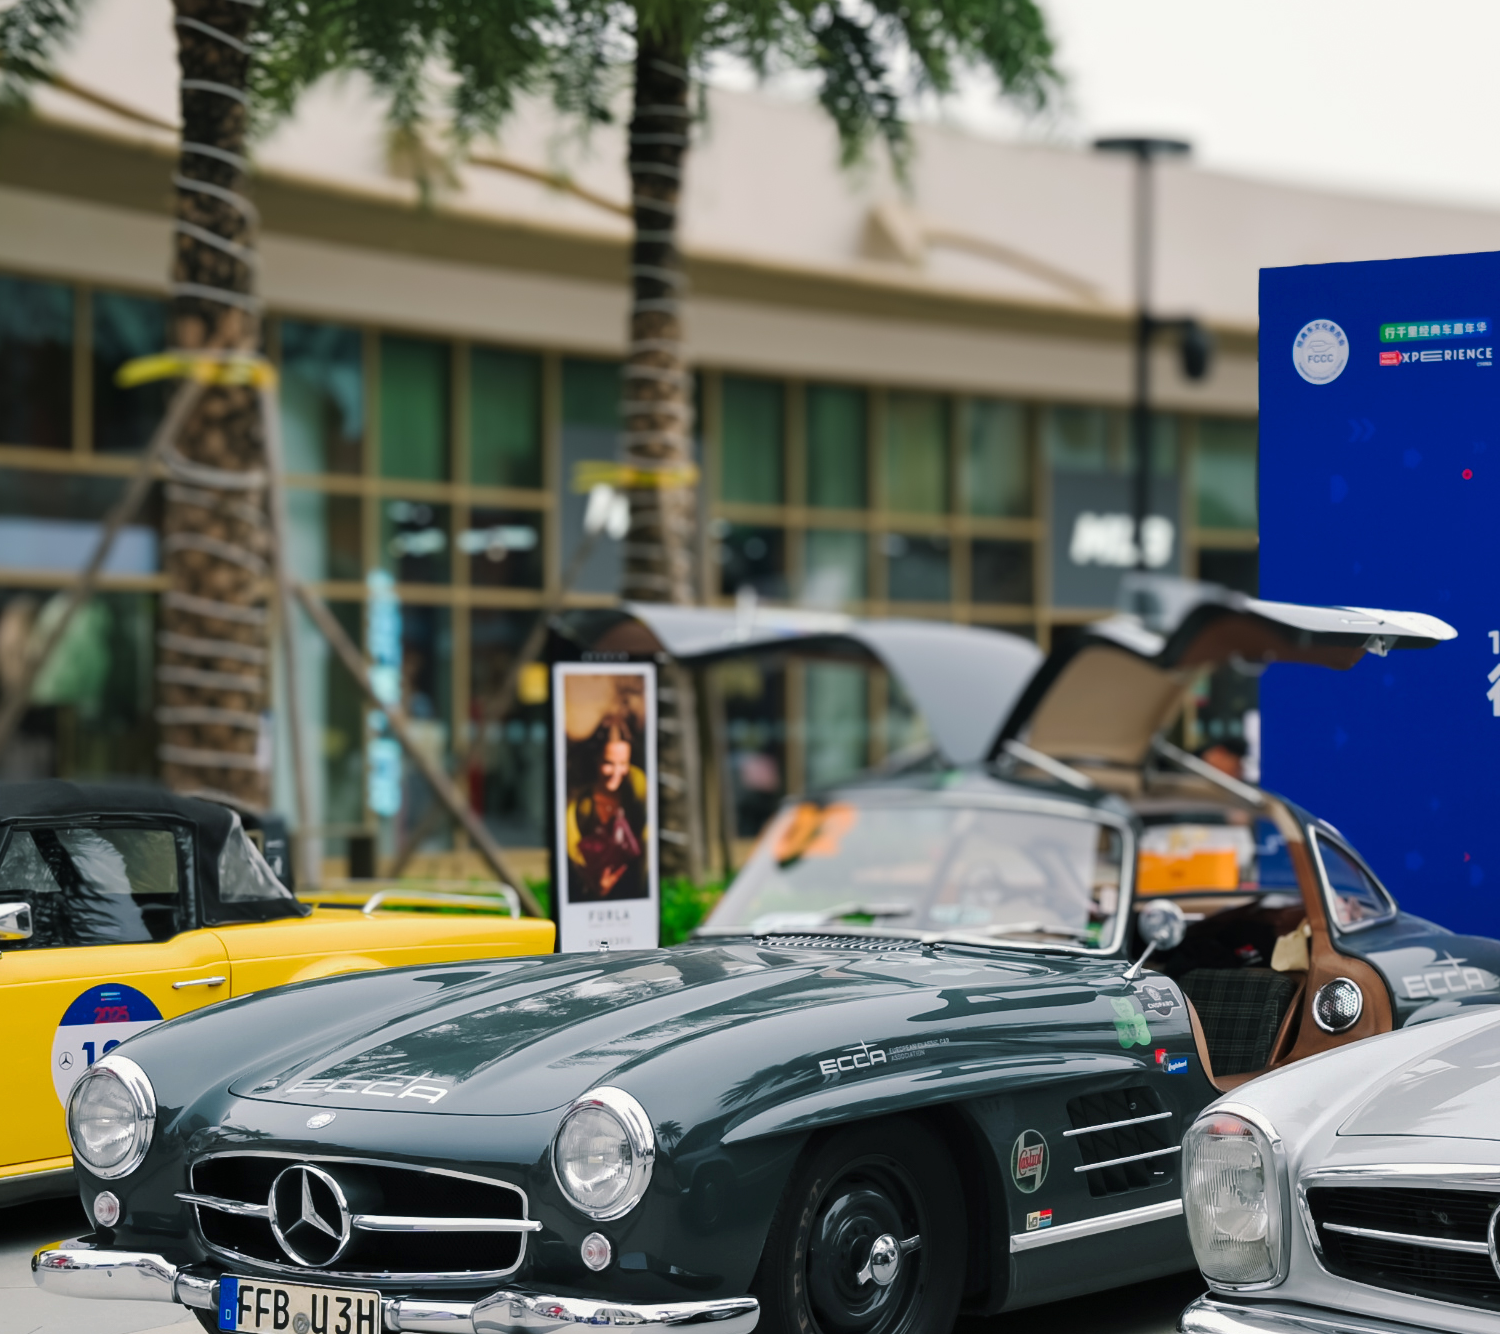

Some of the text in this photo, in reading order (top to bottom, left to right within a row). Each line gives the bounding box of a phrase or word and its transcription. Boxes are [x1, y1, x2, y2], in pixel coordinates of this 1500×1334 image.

[1307, 354, 1335, 364] FCCC
[1402, 968, 1486, 999] ECCA
[818, 1049, 888, 1076] ECCA
[284, 1077, 450, 1105] ECCA
[1017, 1147, 1044, 1176] Castrol
[225, 1309, 232, 1321] D
[237, 1284, 290, 1330] FFB
